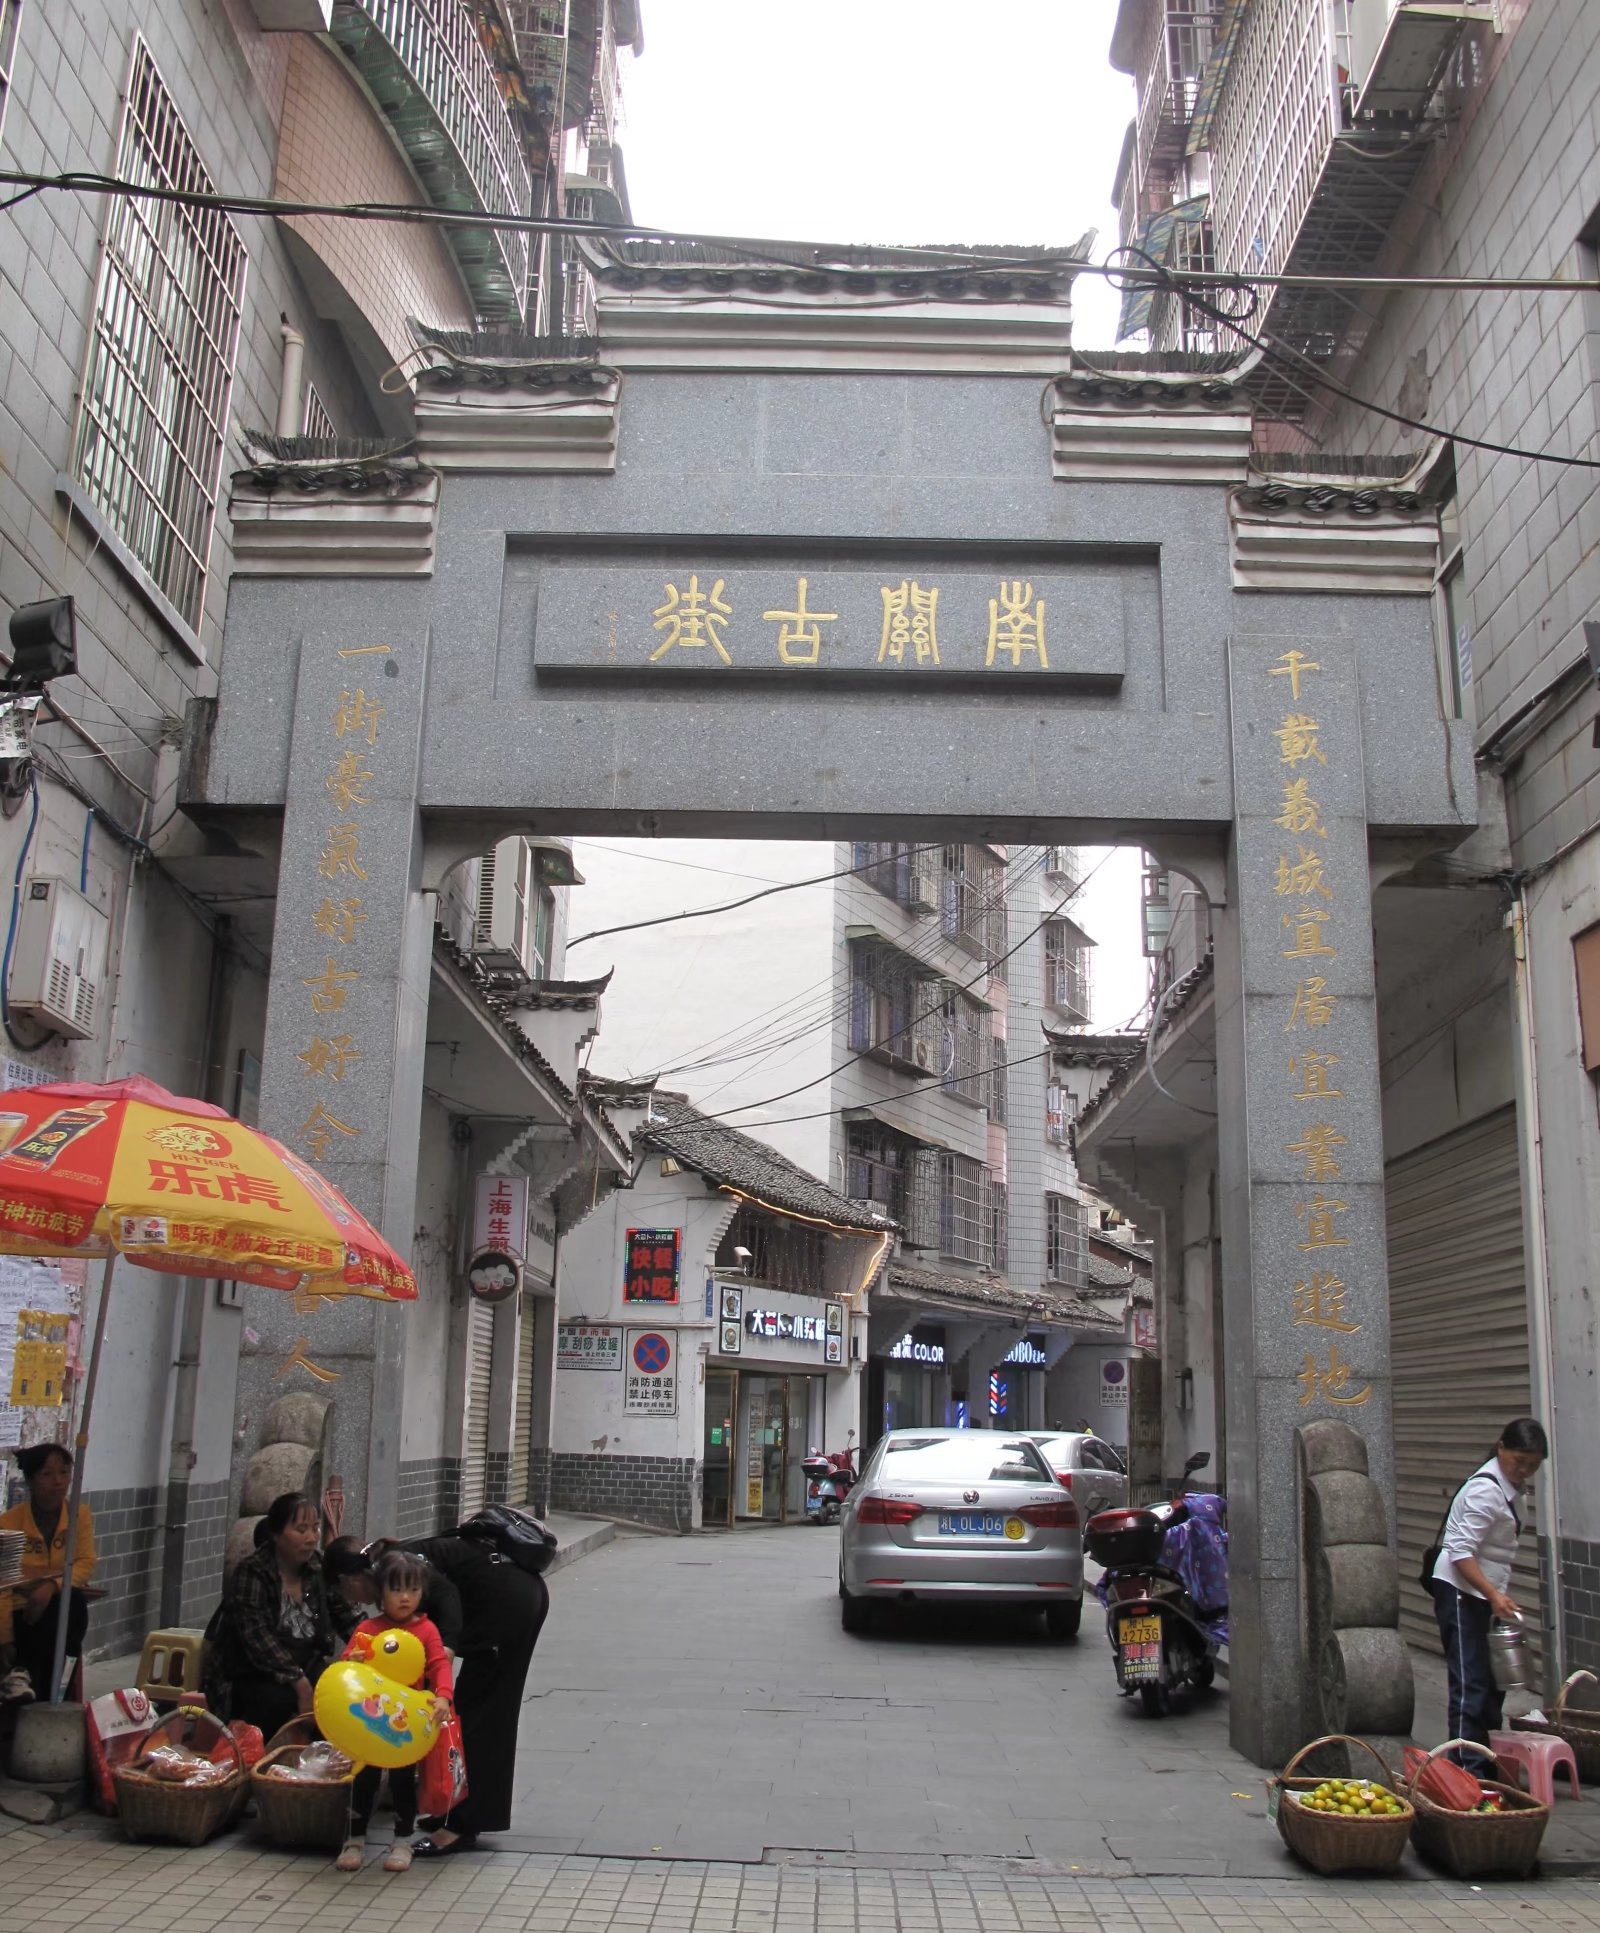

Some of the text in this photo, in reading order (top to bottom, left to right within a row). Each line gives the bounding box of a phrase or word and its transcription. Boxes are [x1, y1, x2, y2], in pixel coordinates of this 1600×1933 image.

[172, 1152, 240, 1171] HI-TIGER
[147, 1158, 293, 1213] 乐虎
[488, 1180, 513, 1254] 上海生煎
[631, 1247, 673, 1270] 快餐
[630, 1275, 673, 1298] 小吃
[914, 1343, 944, 1364] COLOR
[629, 1377, 673, 1388] 消防通道
[629, 1389, 673, 1400] 禁止停车
[1122, 1627, 1159, 1642] 4273G
